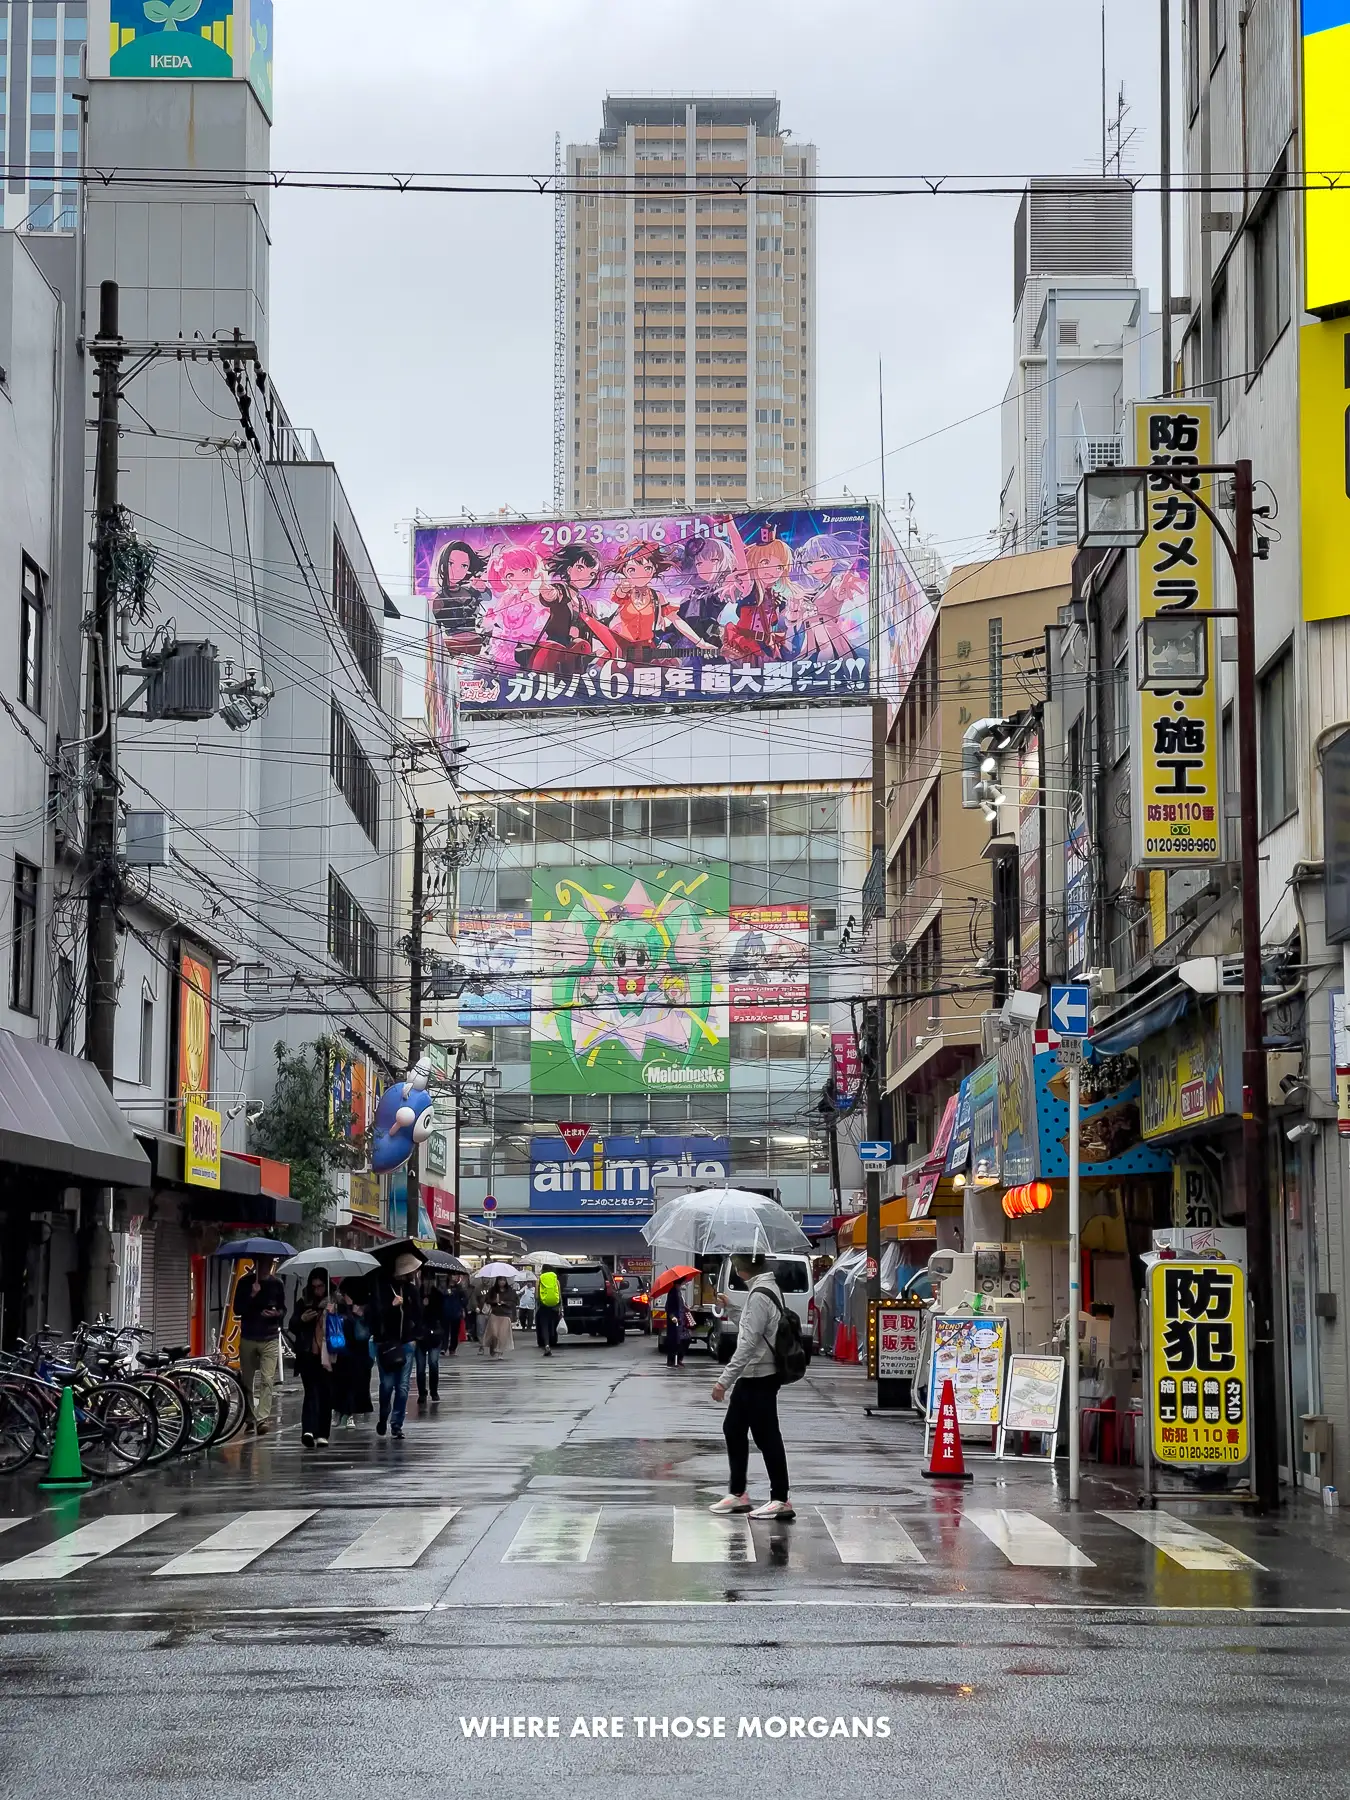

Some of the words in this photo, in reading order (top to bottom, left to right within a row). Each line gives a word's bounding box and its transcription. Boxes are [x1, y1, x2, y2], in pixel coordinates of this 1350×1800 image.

[150, 55, 192, 68] IKEDA
[540, 520, 666, 546] 2023.3.16
[675, 518, 729, 539] Thu
[1148, 413, 1207, 796] 防犯カメラ・施工
[1147, 803, 1215, 822] 防犯110番
[1146, 838, 1217, 852] 0120-998-960
[791, 1009, 808, 1021] 5F
[647, 1065, 725, 1084] Melonbooks
[564, 1128, 586, 1137] 止まれ
[533, 1143, 726, 1192] animate
[580, 1198, 635, 1206] アニメのことなら
[882, 1314, 916, 1330] 買取
[1162, 1268, 1237, 1372] 防犯
[882, 1335, 917, 1351] 販売
[1160, 1380, 1176, 1419] 施工
[1182, 1380, 1198, 1420] 設備
[1204, 1380, 1220, 1420] 機器
[1226, 1381, 1242, 1420] カメラ
[943, 1404, 955, 1459] 駐車禁止
[1179, 1446, 1240, 1460] 0120-325-110
